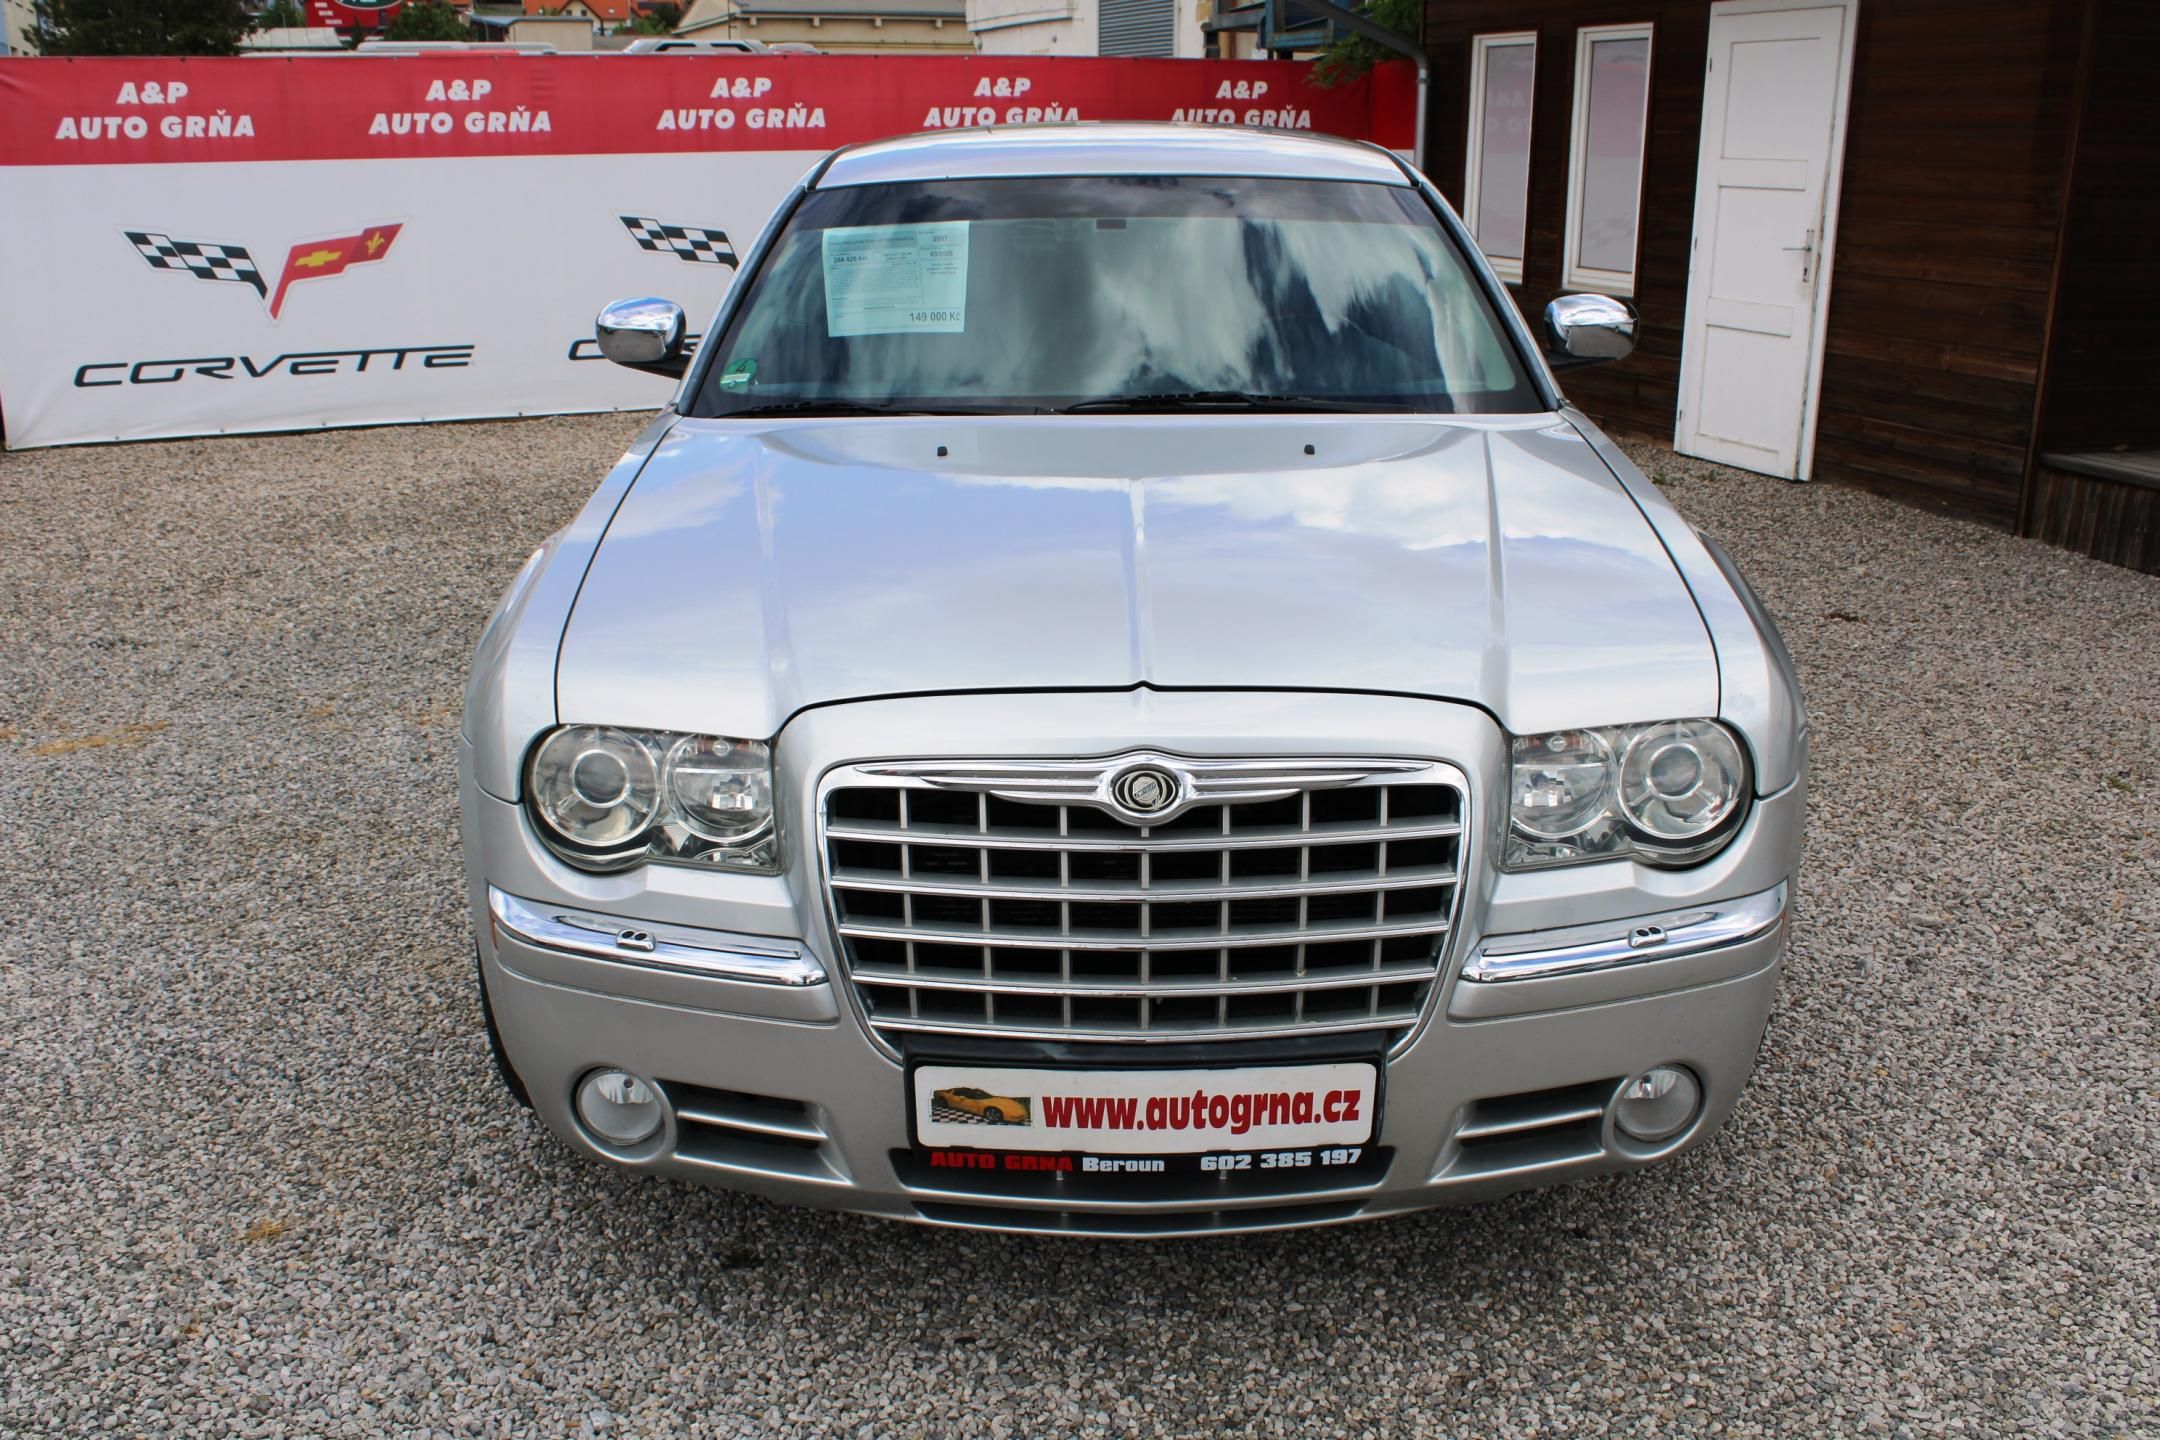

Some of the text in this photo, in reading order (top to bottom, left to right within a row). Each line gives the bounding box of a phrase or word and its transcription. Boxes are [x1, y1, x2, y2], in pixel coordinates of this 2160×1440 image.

[116, 81, 188, 104] A&P
[425, 79, 492, 101] A&P
[709, 77, 772, 98] A&P
[973, 77, 1031, 97] A&P
[1215, 80, 1268, 99] A&P
[55, 108, 255, 139] AUTO GRŇA
[368, 105, 552, 135] AUTO GRŇA
[656, 102, 826, 130] AUTO GRŇA
[923, 101, 1079, 127] AUTO GRŇA
[1172, 104, 1311, 128] AUTO GRŇA
[910, 311, 960, 322] 149 000 Kč
[74, 344, 475, 388] CORVETTE
[736, 359, 748, 373] 4
[1042, 1088, 1361, 1134] www.autogrna.cz
[930, 1148, 1362, 1172] AUTO GRNA Beroun 602 385 197
